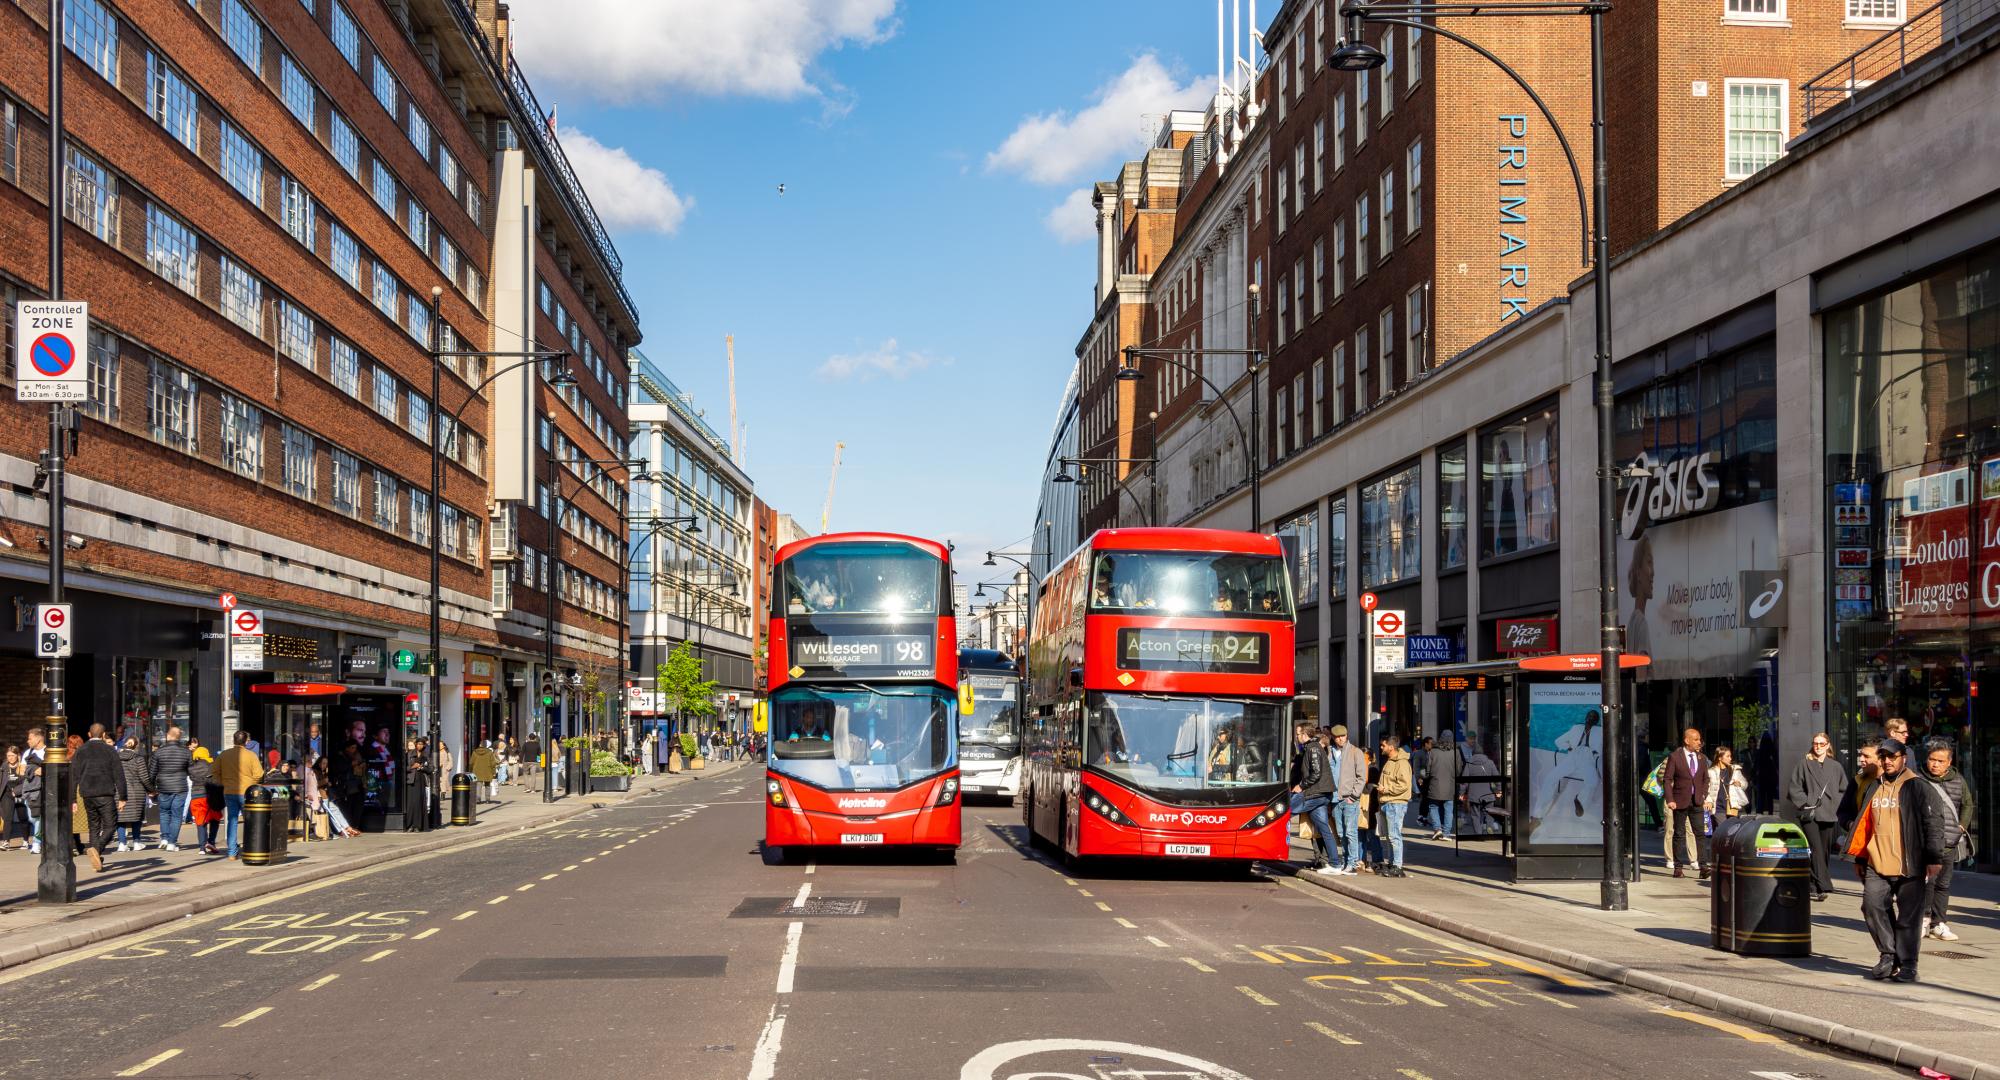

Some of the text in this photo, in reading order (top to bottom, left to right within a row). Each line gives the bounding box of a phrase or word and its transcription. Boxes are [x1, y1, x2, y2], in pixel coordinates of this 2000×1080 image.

[1499, 115, 1528, 321] PRIMARK
[23, 305, 83, 314] Controlled
[32, 317, 74, 329] ZONE
[1904, 529, 1970, 567] London
[222, 595, 234, 608] K
[1364, 594, 1374, 608] P
[1666, 584, 1689, 605] Move
[1689, 583, 1709, 608] your
[1904, 580, 1969, 614] Luggages
[1506, 624, 1542, 639] Pizza
[1670, 617, 1693, 636] move
[1694, 615, 1713, 639] your
[1128, 636, 1260, 660] Acton Green 94
[1410, 638, 1451, 650] MONEY
[1512, 636, 1538, 648] Hut
[802, 640, 924, 661] Willesden 98
[1410, 650, 1451, 660] EXCHANGE
[818, 655, 861, 663] BUS GARAGE
[1603, 705, 1609, 714] 9
[838, 796, 887, 809] Metroline
[1871, 797, 1900, 809] BOS
[1150, 813, 1228, 824] RATP GROUP
[1170, 846, 1206, 854] LG71 DWU
[218, 910, 429, 931] BUS
[98, 932, 406, 960] STOP
